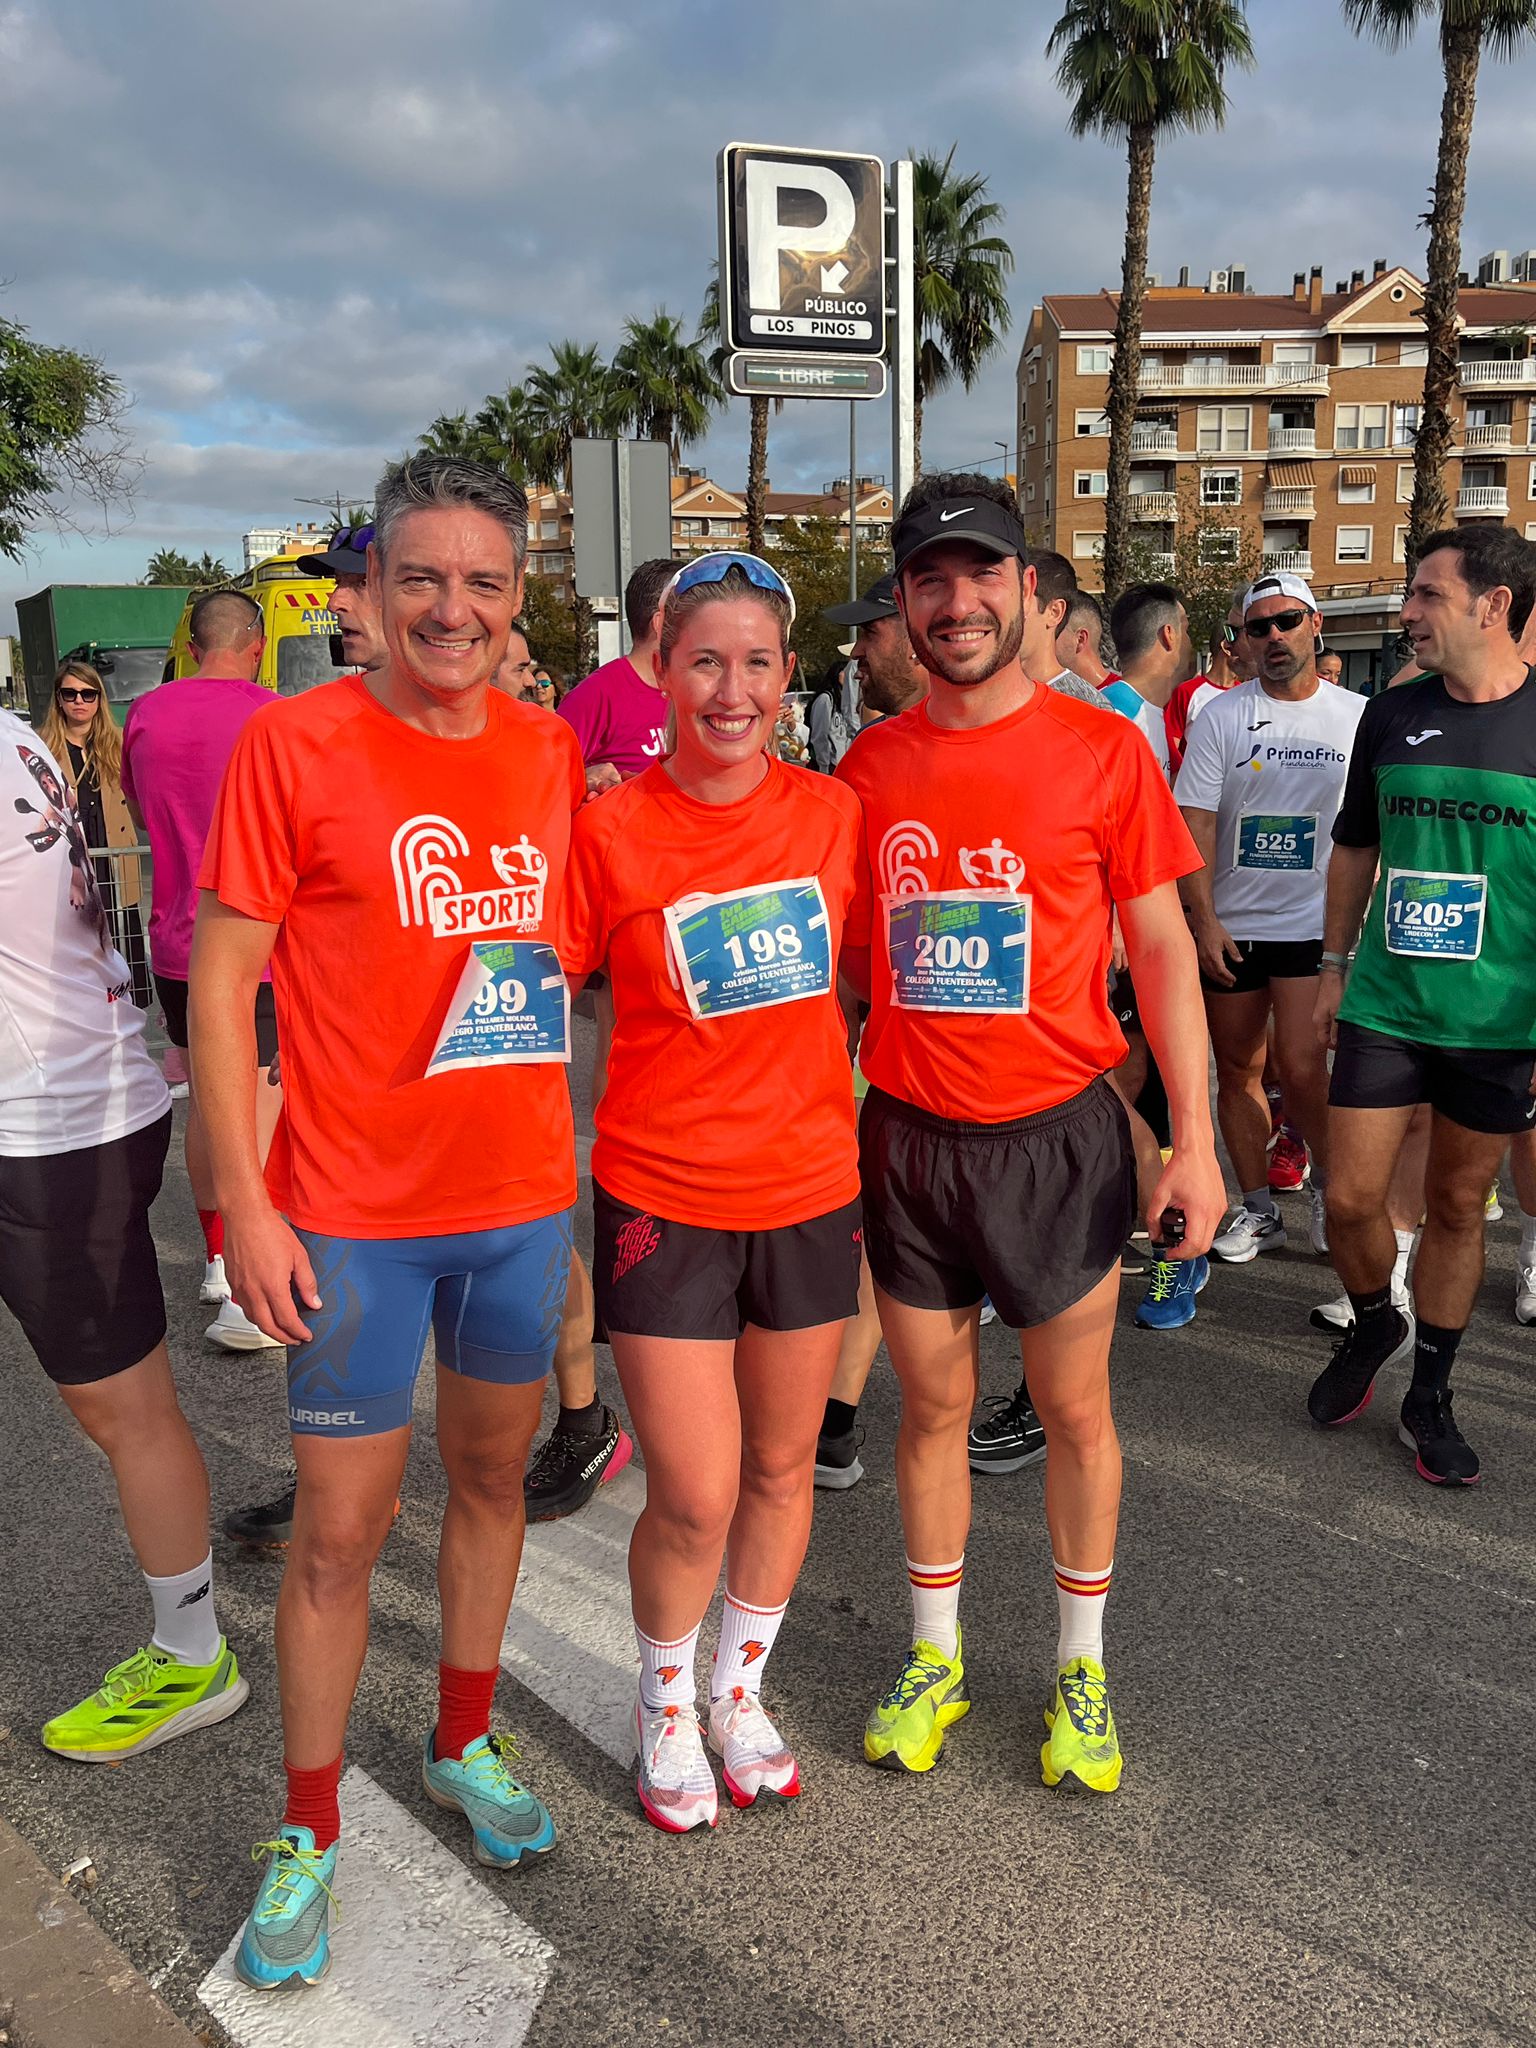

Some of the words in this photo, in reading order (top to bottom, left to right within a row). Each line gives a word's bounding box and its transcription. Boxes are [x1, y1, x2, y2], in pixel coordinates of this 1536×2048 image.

[746, 159, 856, 310] P
[805, 296, 867, 315] PÚBLICO
[768, 319, 794, 333] LOS
[811, 321, 856, 336] PINOS
[779, 368, 835, 385] LIBRE
[1255, 833, 1297, 850] 525
[444, 889, 537, 931] SPORTS
[1393, 900, 1463, 928] 1205
[723, 924, 803, 969] 198
[914, 934, 990, 970] 200
[722, 974, 758, 989] COLEGIO
[759, 961, 816, 981] FUENTEBLANCA
[905, 975, 935, 985] COLEGIO
[936, 977, 998, 987] FUENTEBLANCA
[475, 1022, 539, 1035] FUENTEBLANCA
